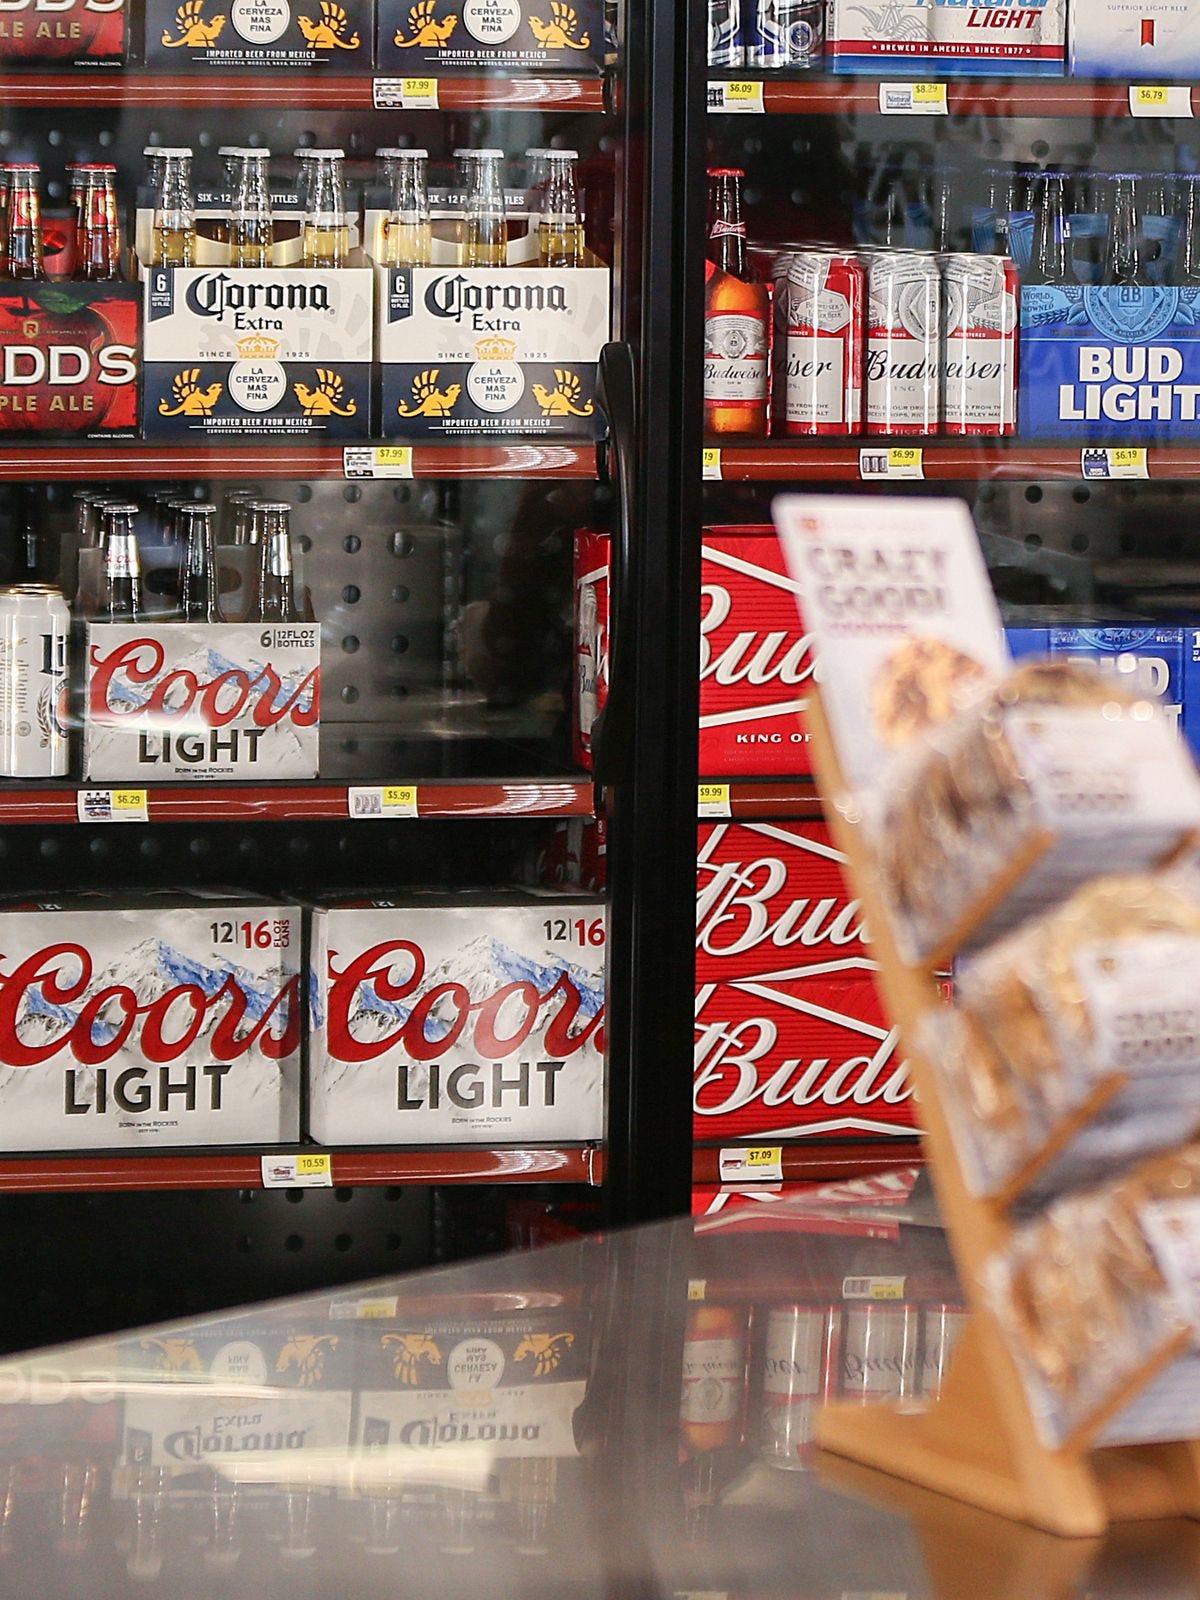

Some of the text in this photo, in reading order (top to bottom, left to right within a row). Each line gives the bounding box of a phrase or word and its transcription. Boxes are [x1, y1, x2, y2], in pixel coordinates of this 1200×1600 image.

[967, 10, 1042, 28] LIGHT
[36, 21, 81, 38] ALE
[207, 50, 243, 58] IMPORTED
[289, 51, 316, 59] MEXICO
[439, 50, 474, 58] IMPORTED
[880, 44, 915, 52] BREWED
[933, 45, 971, 54] AMERICA
[406, 81, 429, 90] $7.99
[730, 84, 752, 93] $6.09
[1141, 90, 1163, 99] $6.79
[198, 194, 231, 203] SIX 12
[448, 195, 458, 204] 12
[157, 274, 166, 292] 6
[396, 276, 405, 292] 6
[185, 272, 330, 321] Corona
[424, 274, 568, 322] Corona
[234, 312, 283, 330] Extra
[473, 314, 521, 331] Extra
[786, 352, 832, 378] iser
[1080, 347, 1183, 382] BUD
[50, 396, 93, 411] ALE
[1059, 384, 1200, 421] LIGHT
[442, 419, 478, 427] IMPORTED
[379, 450, 402, 458] $7.99
[892, 451, 914, 459] $6.99
[1116, 450, 1137, 459] $6.19
[260, 631, 272, 648] 6
[89, 638, 321, 728] Coors
[138, 728, 267, 763] LIGHT
[737, 733, 813, 743] KING OF
[117, 795, 140, 805] $6.29
[388, 791, 410, 801] $5.99
[700, 788, 722, 797] $9.99
[211, 920, 271, 949] 12 16
[282, 919, 290, 948] CANS
[543, 918, 605, 946] 12 16
[65, 1065, 232, 1115] LIGHT
[397, 1062, 566, 1111] LIGHT
[750, 1150, 772, 1161] $7.09
[302, 1158, 325, 1169] 10.59
